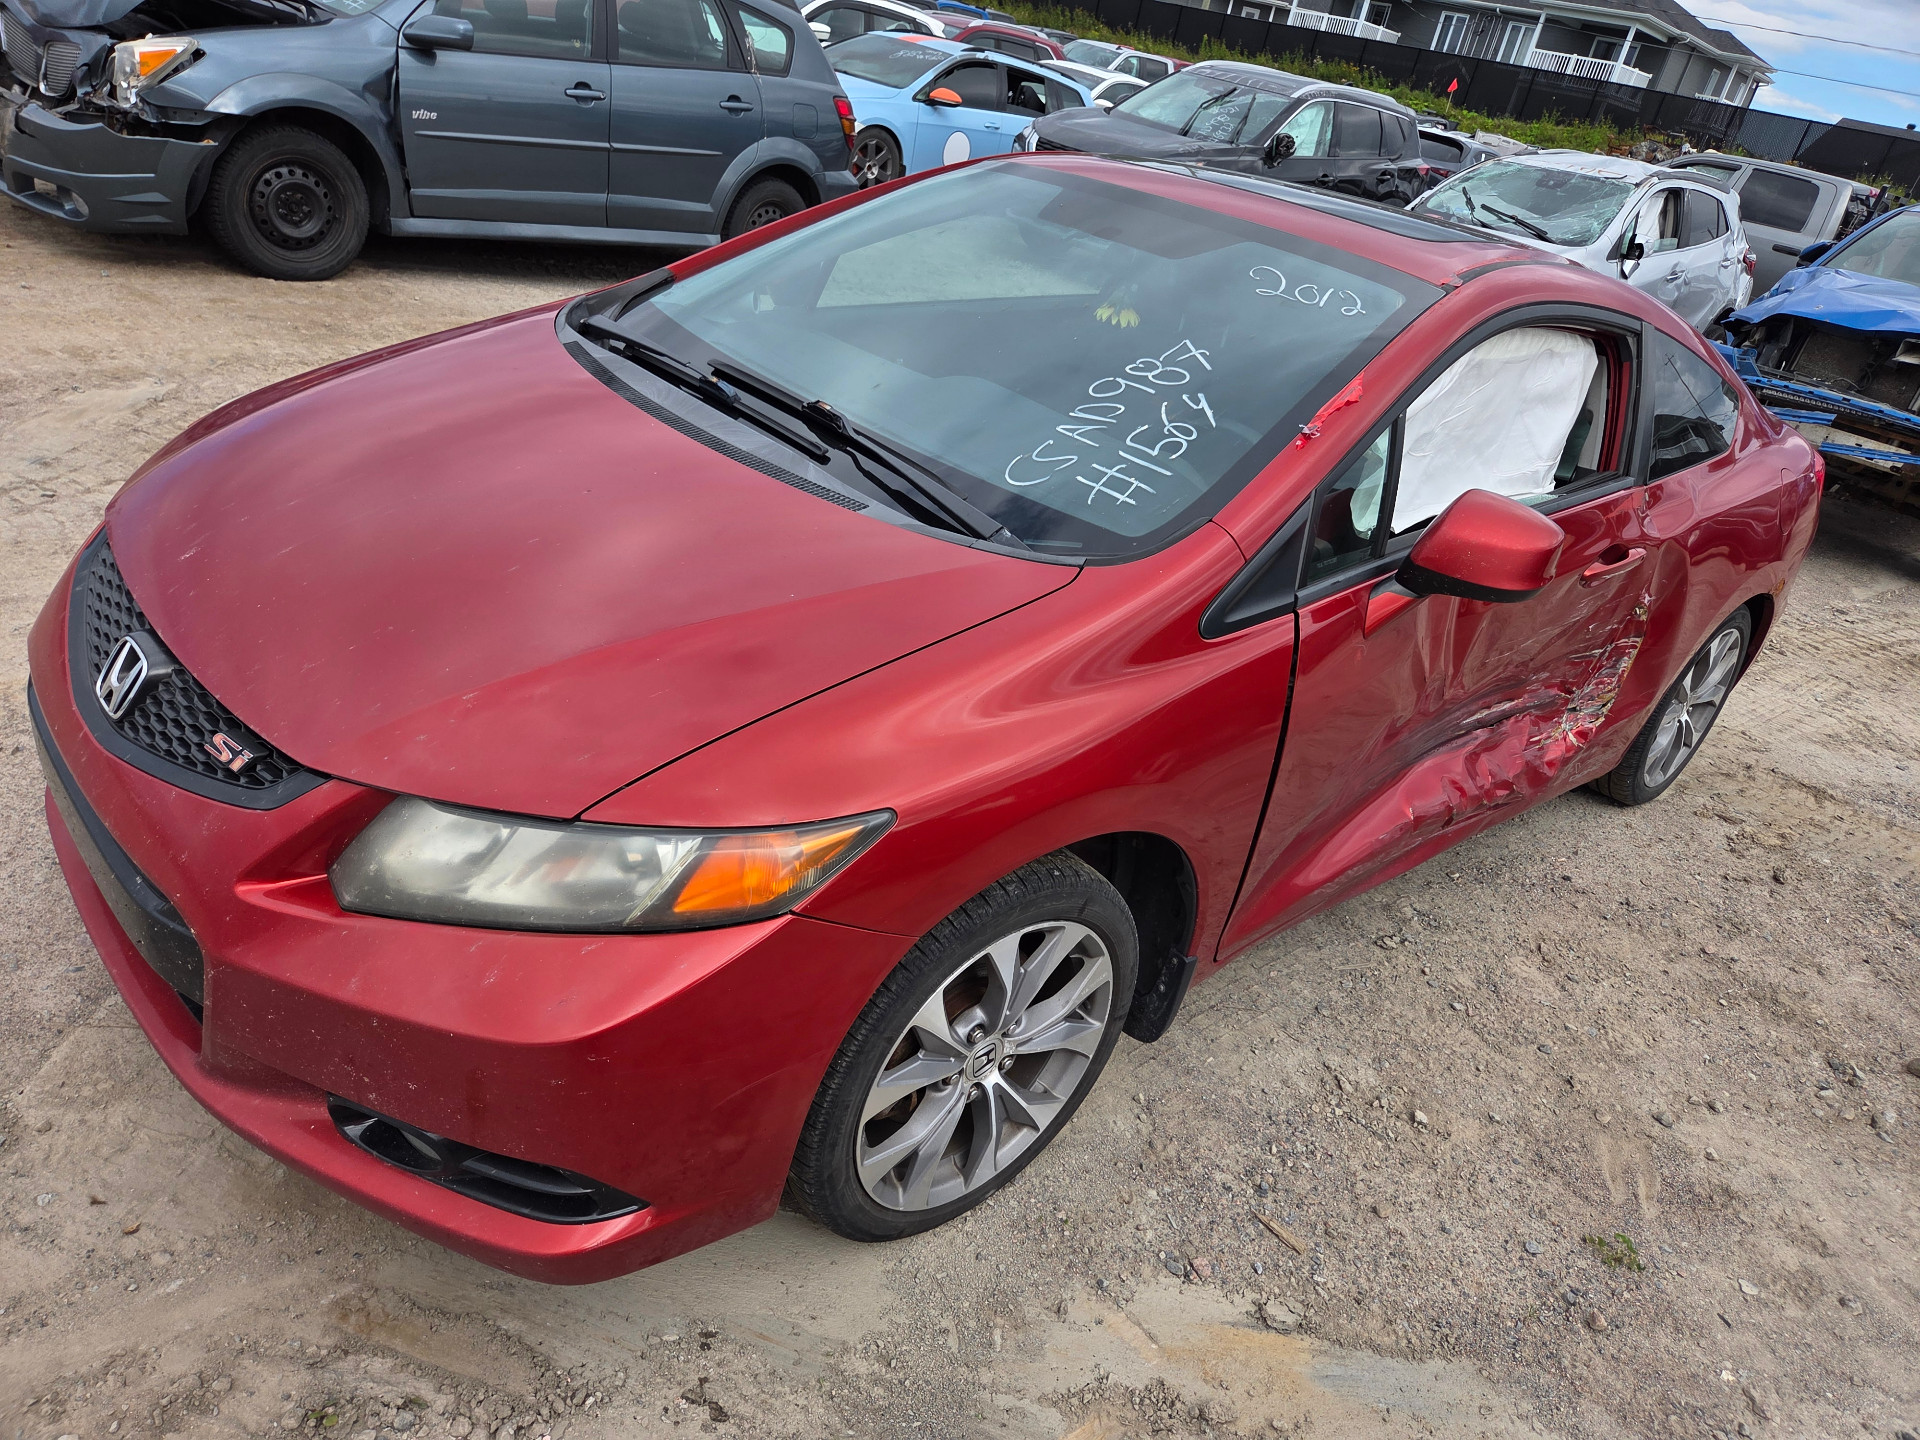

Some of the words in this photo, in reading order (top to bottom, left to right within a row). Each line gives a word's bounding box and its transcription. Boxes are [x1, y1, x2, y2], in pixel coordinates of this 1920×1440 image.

[1249, 265, 1366, 316] 2012
[1004, 339, 1212, 486] CSAD987
[1075, 392, 1216, 505] #1564
[204, 733, 253, 772] Si
